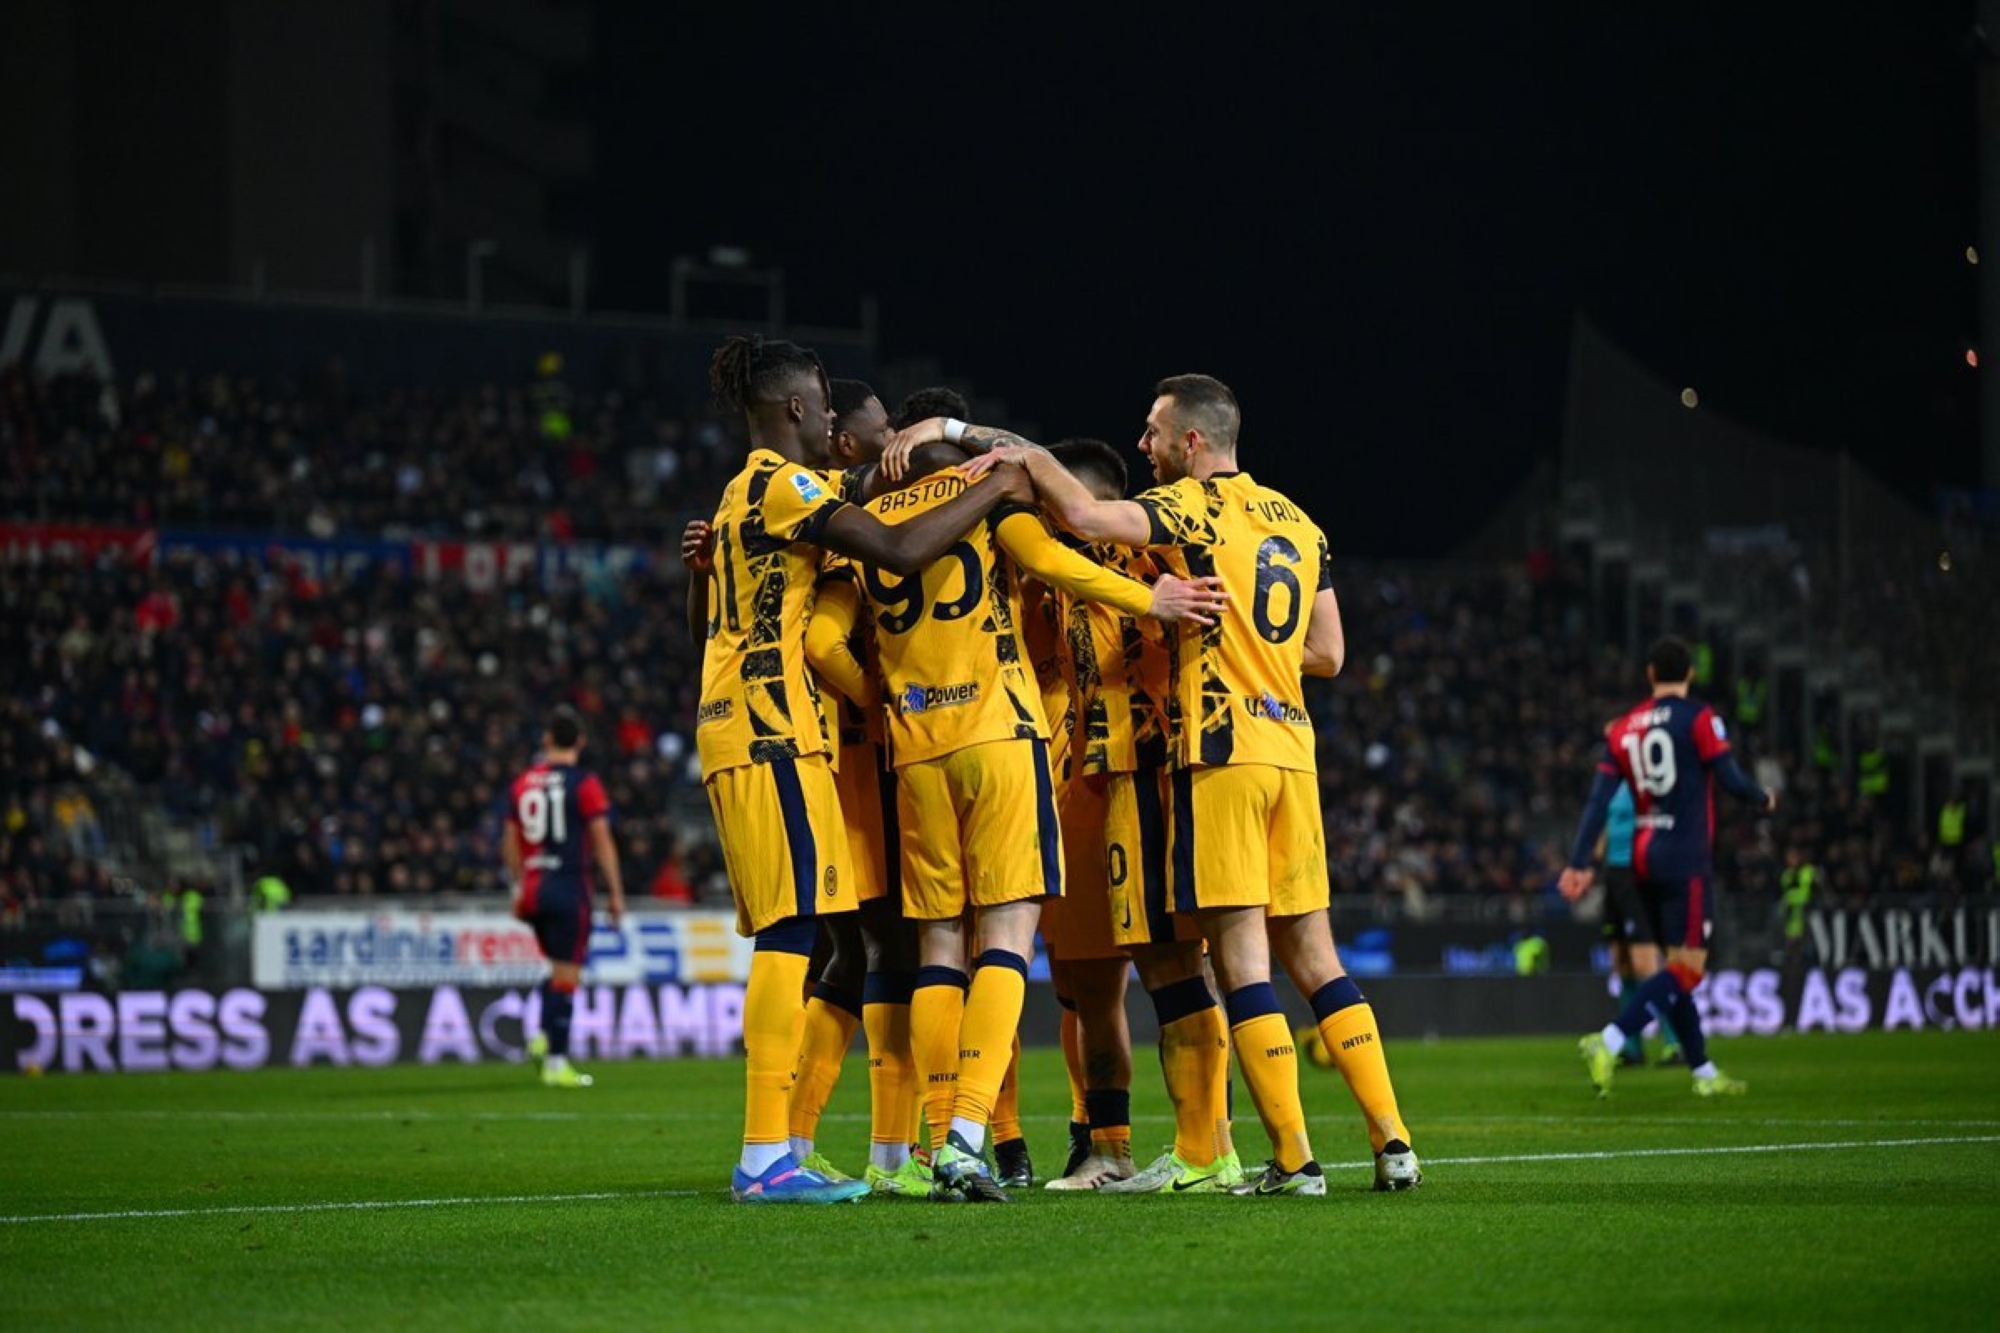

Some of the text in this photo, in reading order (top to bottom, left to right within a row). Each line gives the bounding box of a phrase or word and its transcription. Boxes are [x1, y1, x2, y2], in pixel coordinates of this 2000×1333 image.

[1252, 535, 1301, 644] 6
[1620, 727, 1677, 798] 19
[518, 787, 567, 842] 91
[292, 985, 399, 1065] AS
[418, 985, 480, 1064] A
[1799, 966, 1872, 1034] AS
[1883, 964, 1925, 1031] A
[1342, 1033, 1373, 1050] INTER
[928, 1073, 958, 1083] INTER
